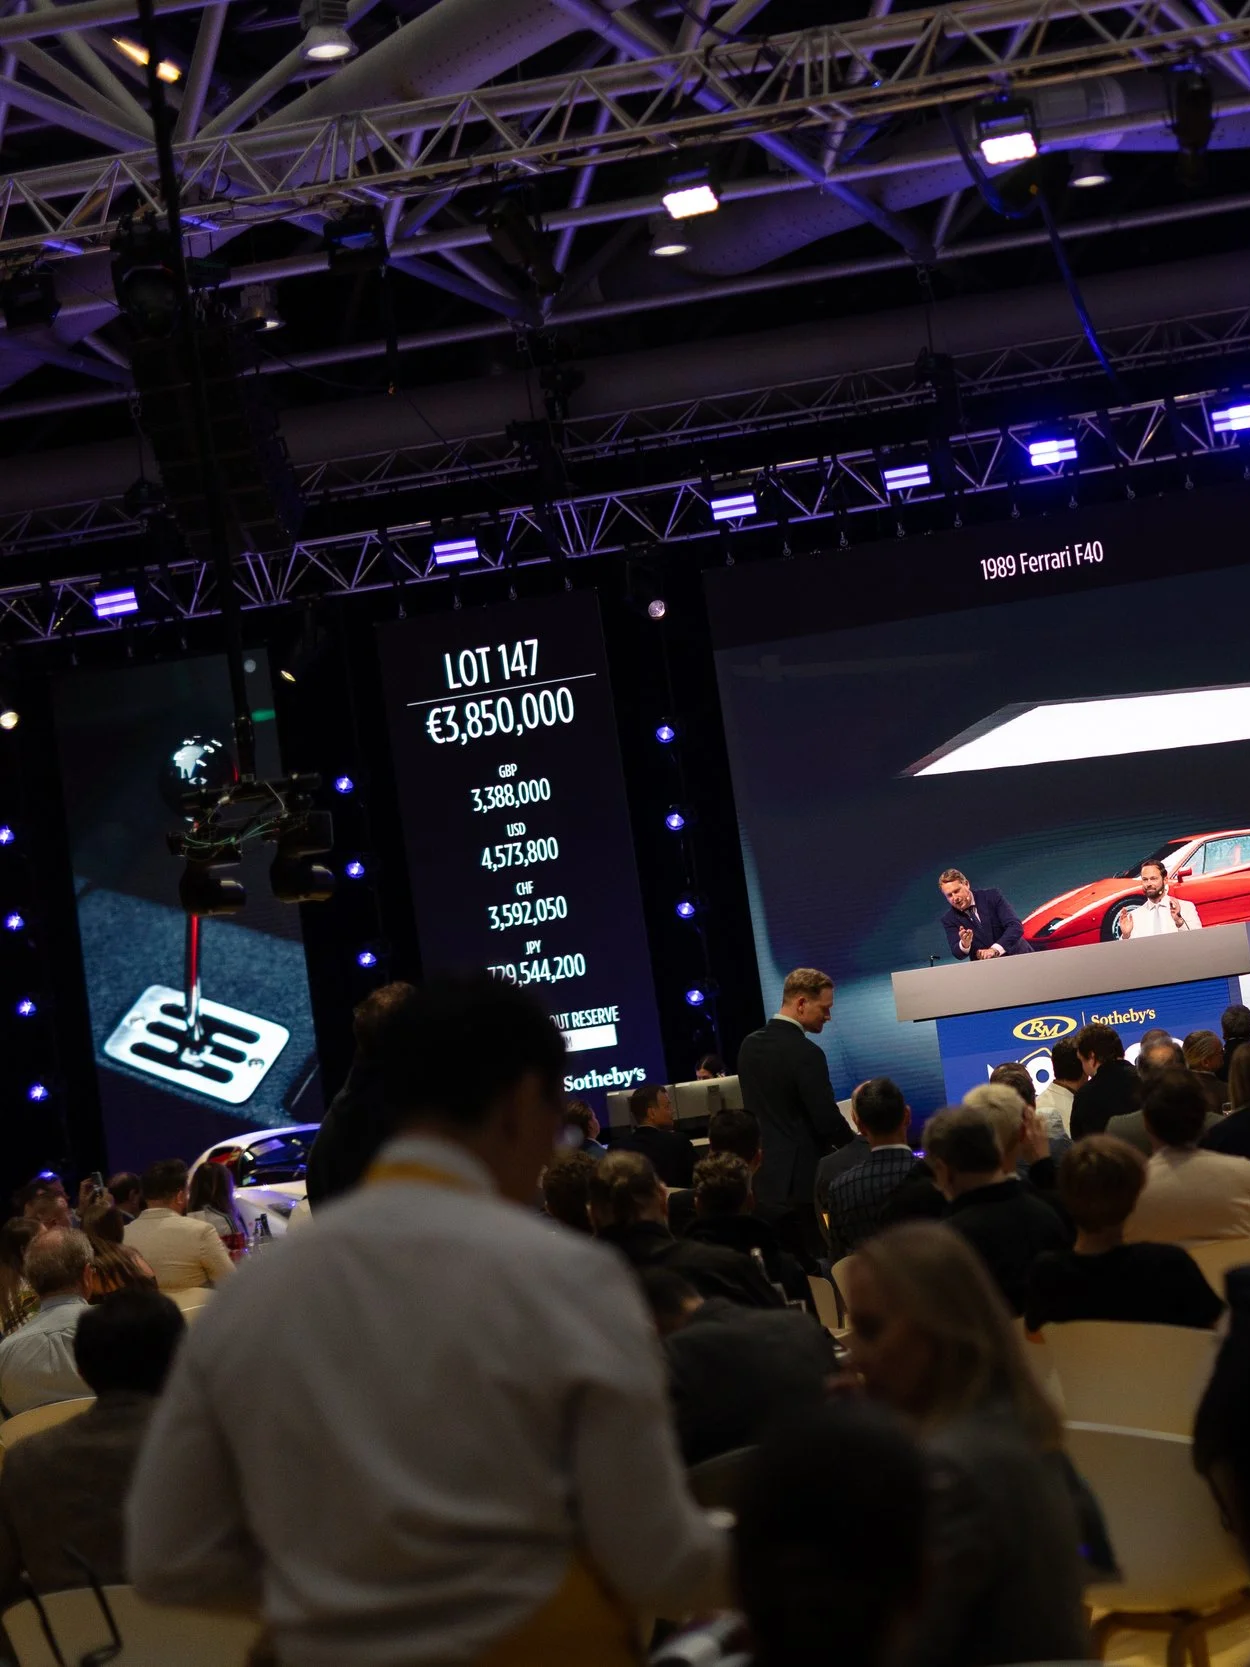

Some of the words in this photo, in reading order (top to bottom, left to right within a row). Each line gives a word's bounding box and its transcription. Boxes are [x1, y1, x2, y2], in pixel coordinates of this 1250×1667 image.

[980, 555, 1016, 580] 1989
[1020, 546, 1072, 574] Ferrari
[1074, 541, 1104, 565] F40
[445, 647, 490, 689] LOT
[498, 639, 539, 680] 147
[426, 687, 574, 745] €3,850,000
[498, 763, 518, 778] GBP
[470, 778, 551, 812] 3,388,000
[506, 822, 526, 837] USD
[481, 837, 559, 870] 4,573,800
[516, 881, 534, 896] CHF
[488, 896, 567, 931] 3,592,050
[525, 940, 542, 955] JPY
[572, 1006, 620, 1027] RESERVE
[1091, 1008, 1156, 1026] Sotheby's
[563, 1066, 647, 1092] Sotheby's
